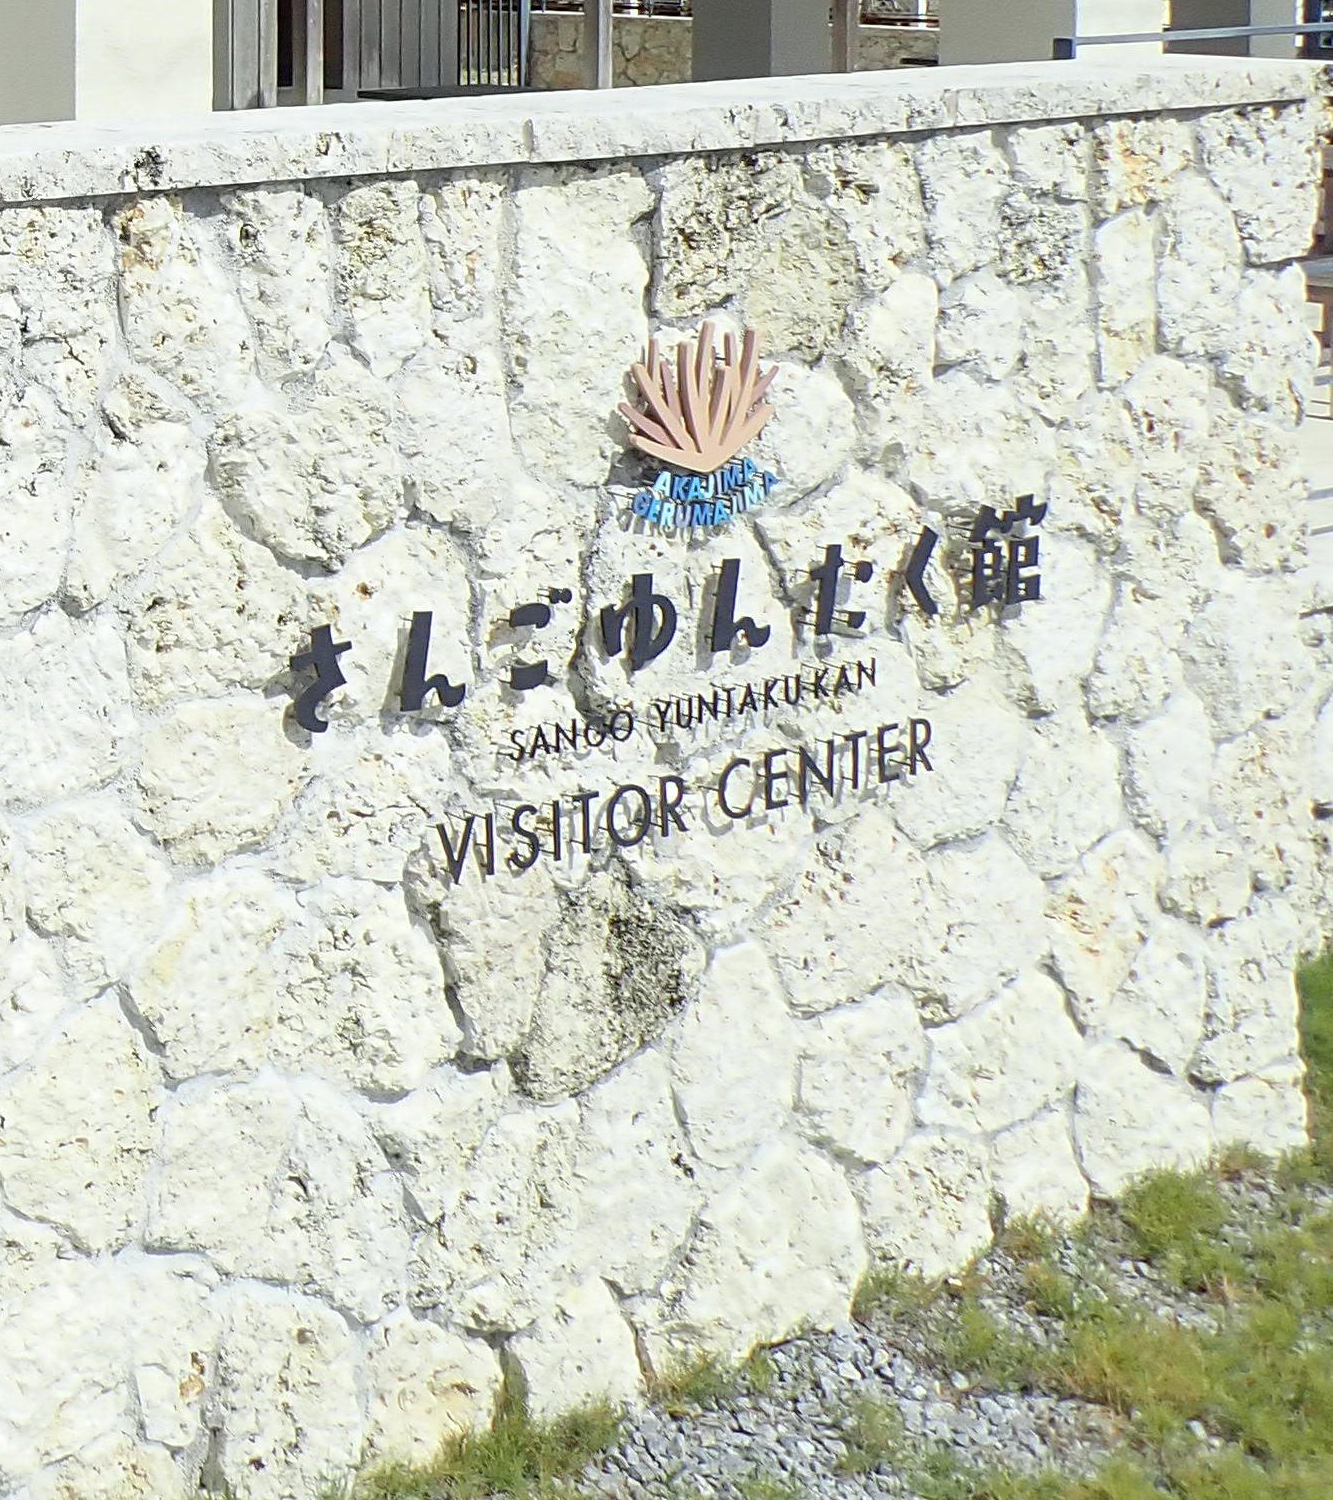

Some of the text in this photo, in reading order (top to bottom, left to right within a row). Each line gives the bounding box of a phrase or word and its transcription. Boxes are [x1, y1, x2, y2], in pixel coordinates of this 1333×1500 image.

[633, 470, 781, 528] GERUMAJIMA
[652, 457, 759, 500] AKAJIMA
[289, 495, 1047, 732] さんごゆんたく館
[510, 710, 635, 762] SANGO
[437, 718, 933, 884] VISITOR CENTER
